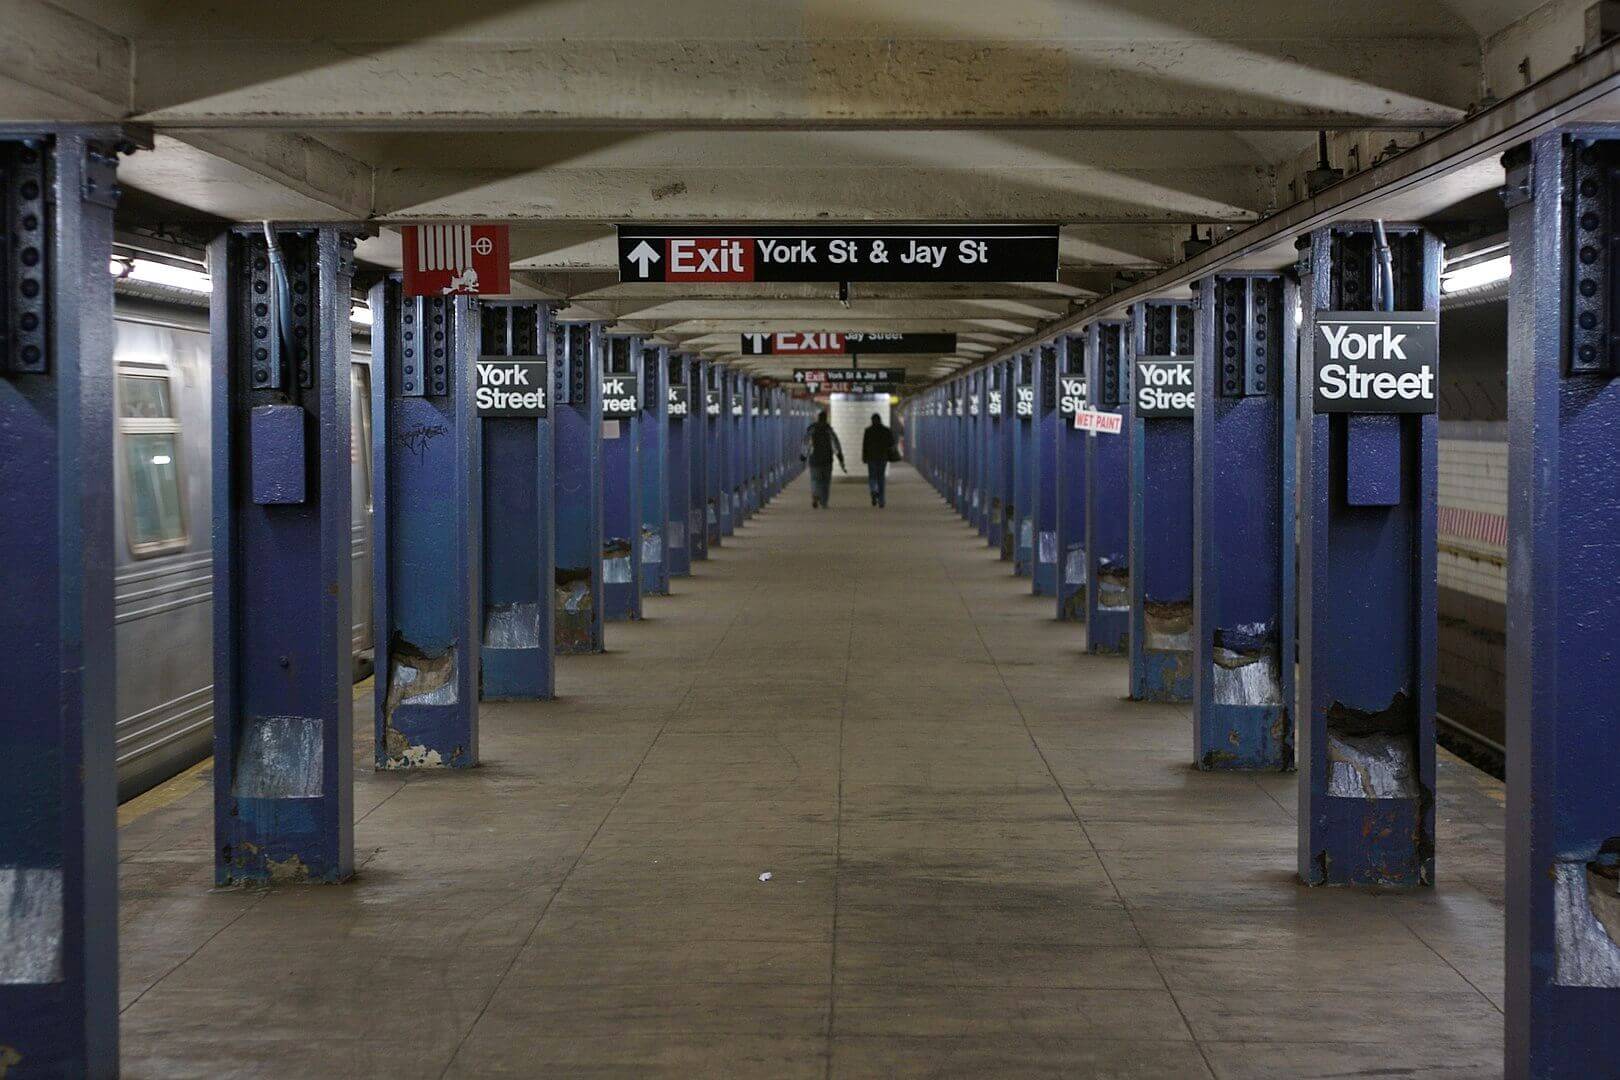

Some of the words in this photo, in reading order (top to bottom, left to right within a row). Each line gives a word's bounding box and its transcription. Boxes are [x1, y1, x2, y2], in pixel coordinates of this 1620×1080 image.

[671, 239, 744, 272] Exit
[757, 239, 817, 263] York
[828, 239, 858, 264] St
[869, 239, 889, 264] &
[900, 240, 947, 268] Jay
[958, 239, 988, 264] St
[1320, 325, 1407, 360] York
[476, 364, 529, 385] York
[805, 371, 825, 382] Exit
[1139, 364, 1192, 386] York
[1319, 364, 1434, 400] Street
[476, 388, 546, 409] Street
[1061, 380, 1087, 396] Yor
[1139, 387, 1195, 410] Stree
[1077, 414, 1094, 427] WET
[1096, 415, 1121, 430] PAINT
